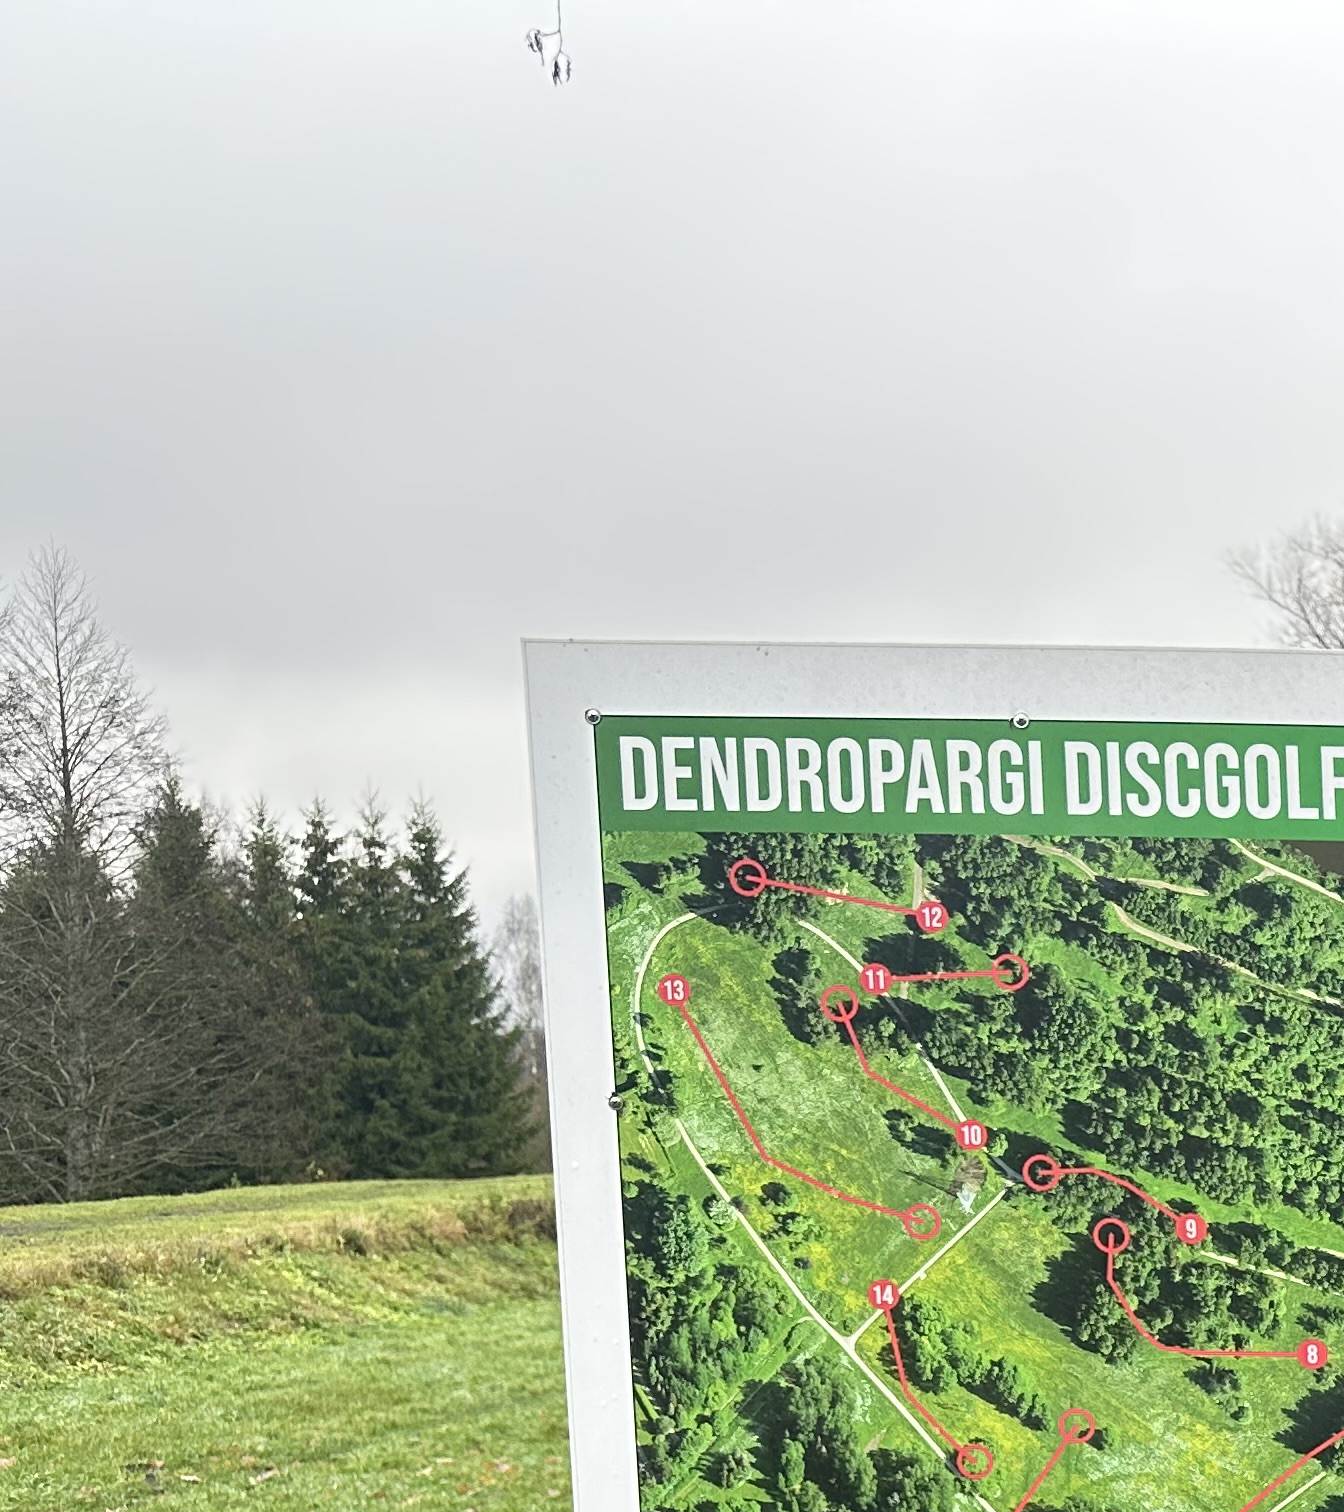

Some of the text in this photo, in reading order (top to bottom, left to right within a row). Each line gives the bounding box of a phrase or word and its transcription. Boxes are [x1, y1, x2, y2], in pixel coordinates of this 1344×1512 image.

[619, 735, 1045, 816] DENDROPARGI
[922, 907, 942, 927] 12
[866, 970, 884, 989] 11
[664, 980, 684, 1000] 13
[961, 1125, 981, 1145] 10
[873, 1285, 893, 1304] 14
